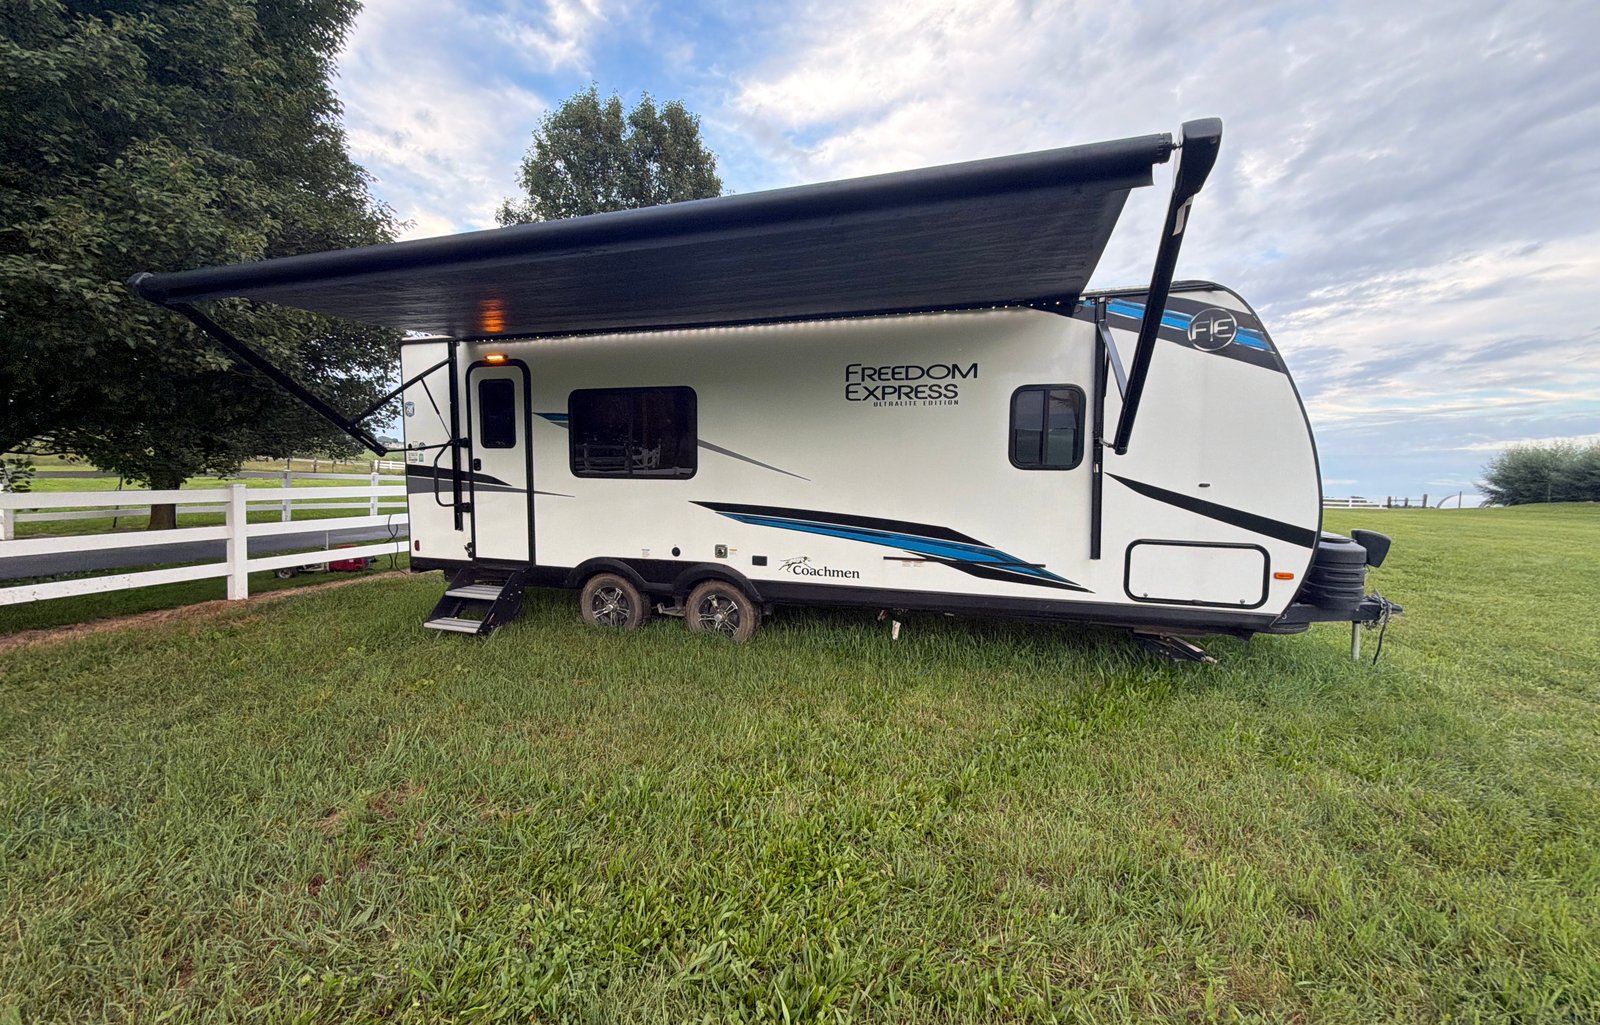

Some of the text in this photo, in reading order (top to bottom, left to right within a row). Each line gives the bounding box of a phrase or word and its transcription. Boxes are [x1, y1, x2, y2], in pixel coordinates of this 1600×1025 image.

[845, 363, 978, 382] FREEDOM
[845, 383, 959, 401] EXPRESS
[793, 565, 860, 579] Coachmen
